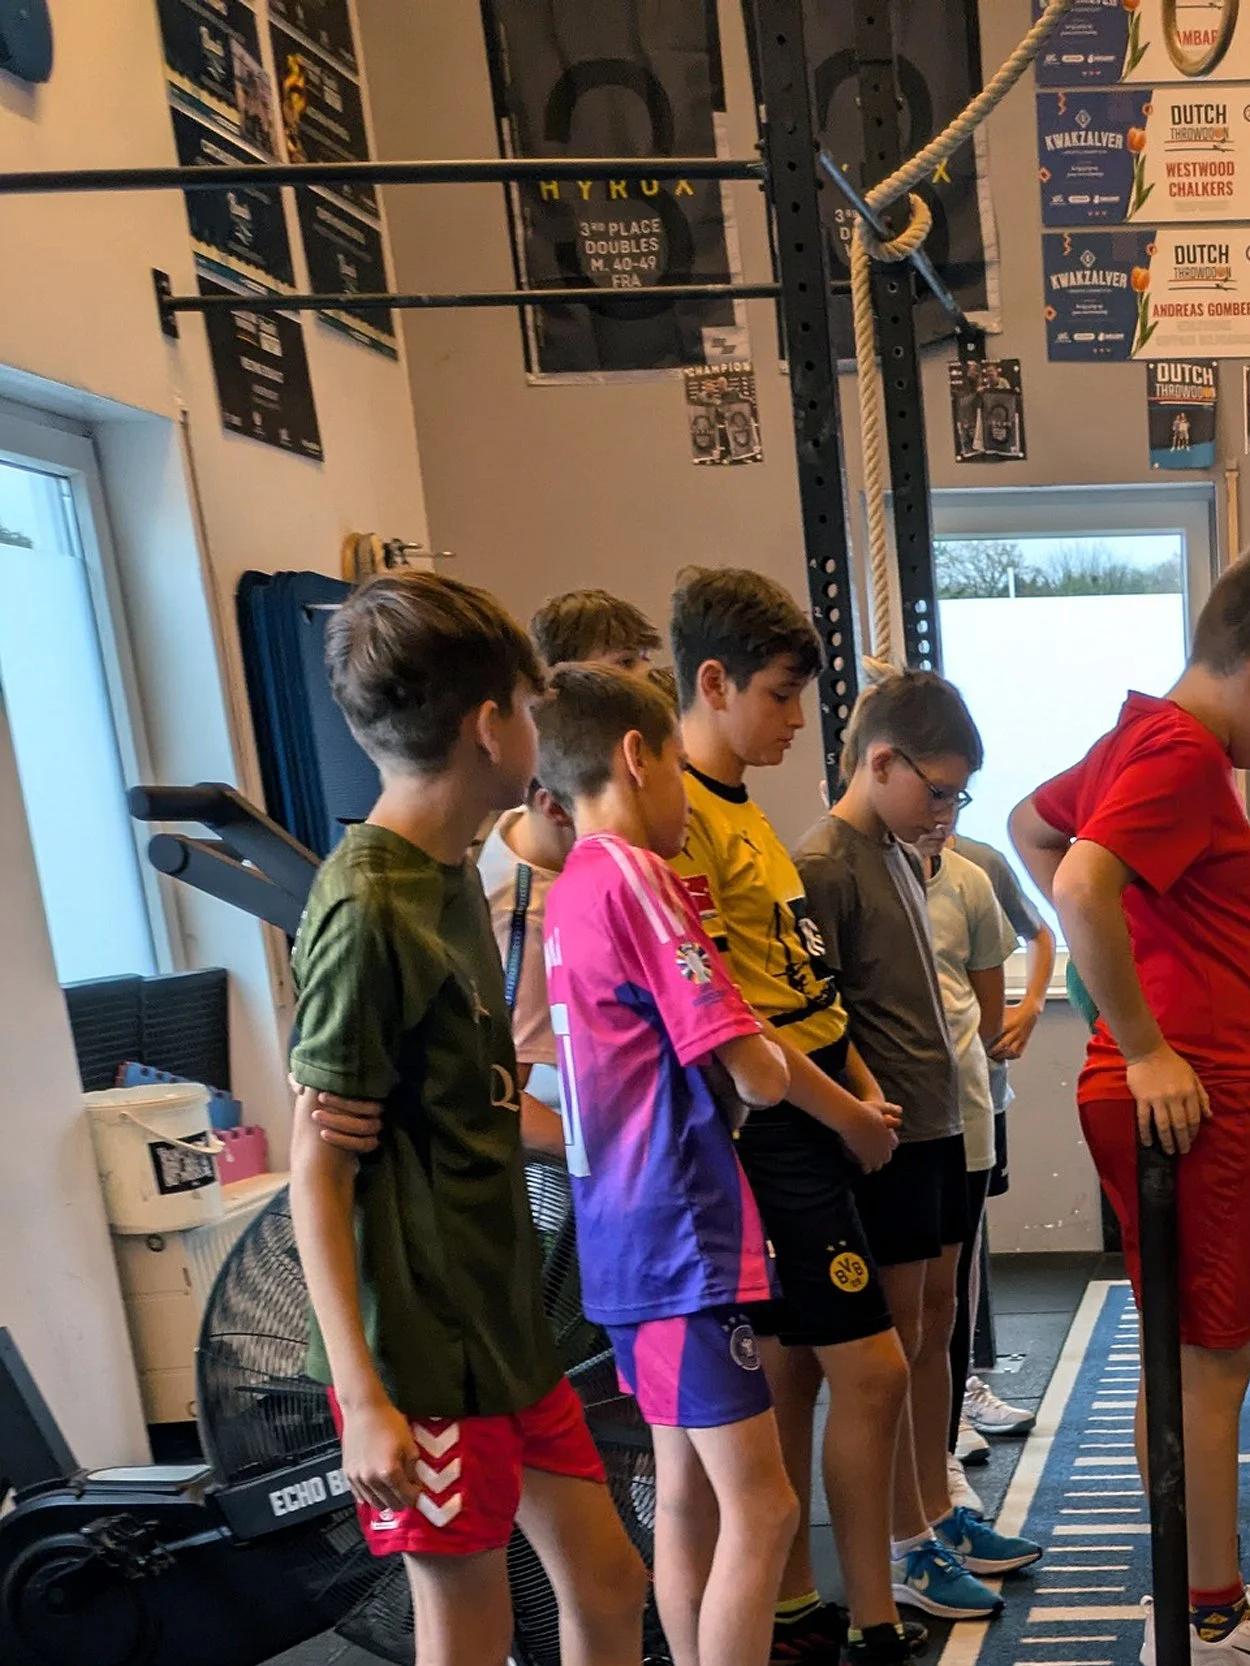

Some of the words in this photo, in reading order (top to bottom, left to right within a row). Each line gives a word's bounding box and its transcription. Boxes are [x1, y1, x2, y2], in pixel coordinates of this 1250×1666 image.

[1171, 104, 1227, 125] DUTCH
[1045, 130, 1123, 151] KWAKZALVER
[1165, 161, 1235, 178] WESTWOOD
[1168, 181, 1234, 197] CHALKERS
[608, 218, 662, 236] PLACE
[585, 238, 660, 255] DOUBLES
[1174, 244, 1230, 264] DUTCH
[613, 256, 657, 271] 40-49
[612, 273, 642, 288] FRA
[1050, 270, 1128, 290] KWAKZALVER
[1152, 303, 1204, 318] ANDREAS
[1156, 363, 1214, 385] DUTCH
[835, 1257, 864, 1285] BVB
[268, 1476, 328, 1517] ECHO
